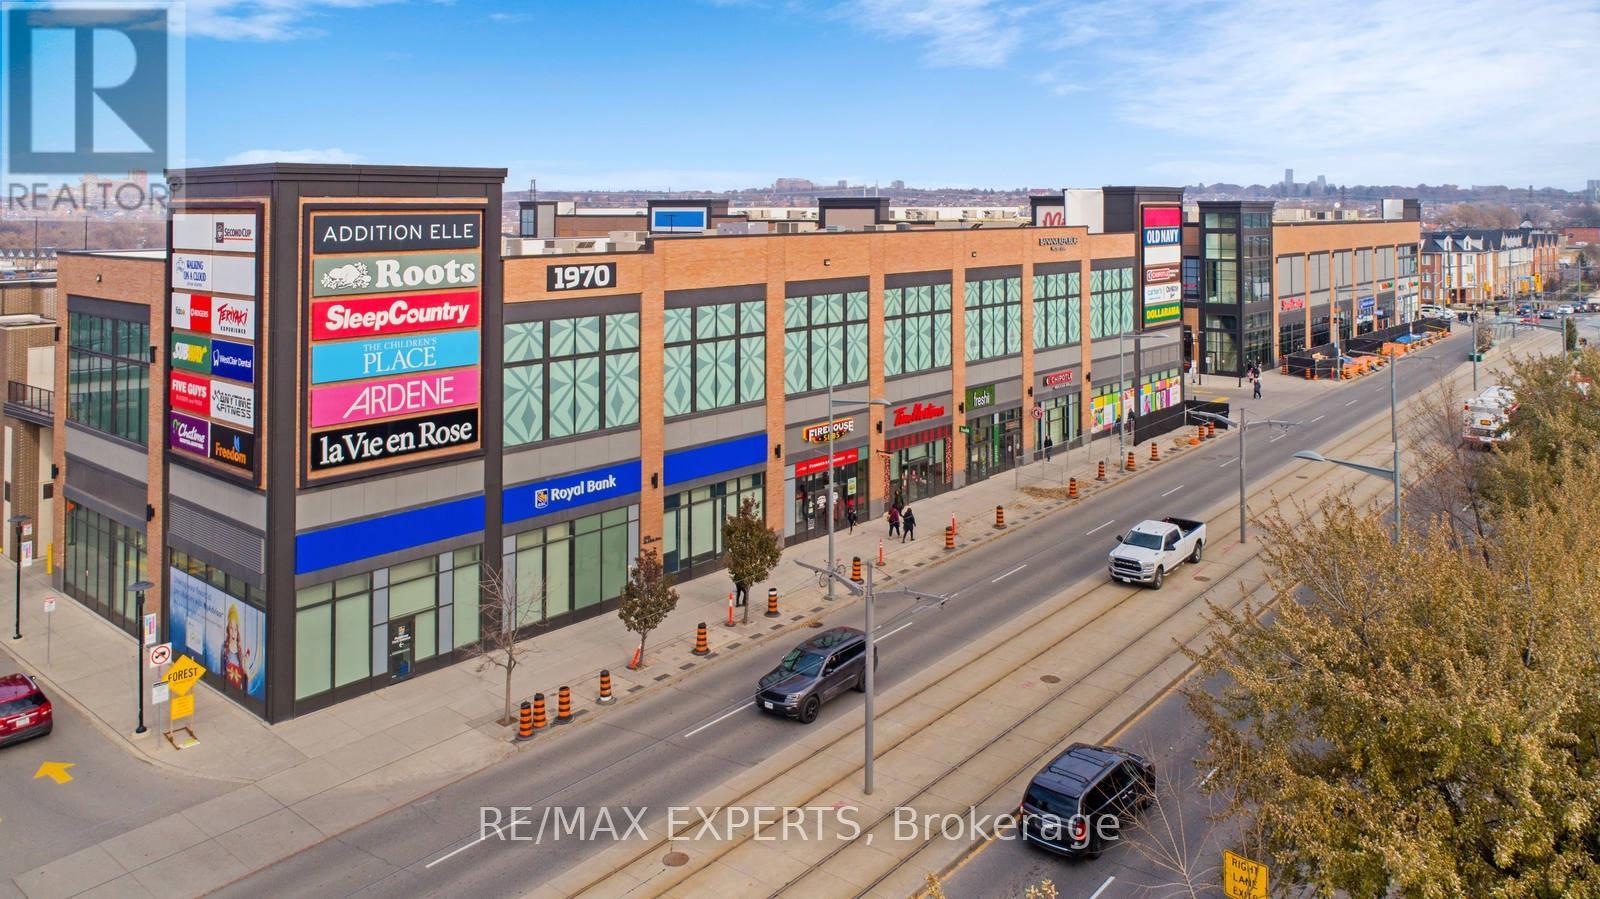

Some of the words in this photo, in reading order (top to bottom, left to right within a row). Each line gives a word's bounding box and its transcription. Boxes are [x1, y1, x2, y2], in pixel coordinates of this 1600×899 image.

[323, 223, 422, 242] ADDITION
[430, 223, 474, 240] ELLE
[1147, 229, 1161, 244] OLD
[1161, 228, 1179, 243] NAVY
[375, 258, 476, 289] Roots
[553, 264, 610, 290] 1970
[325, 300, 471, 331] SleepCountry
[1146, 305, 1180, 320] DOLLARAMA
[220, 326, 246, 335] EXPERIENCE
[173, 342, 207, 364] SUBWAY
[363, 343, 382, 353] THE
[384, 336, 437, 351] CHILDREN'S
[238, 358, 251, 368] Dental
[363, 346, 437, 375] PLACE
[172, 379, 187, 393] FIVE
[187, 383, 207, 398] GUYS
[342, 376, 455, 419] ARDENE
[220, 391, 252, 410] ANYTIME
[220, 403, 252, 419] FITNESS
[178, 423, 206, 443] Chatime
[386, 433, 415, 453] en
[418, 421, 473, 448] Rose
[215, 442, 247, 465] Freedom
[551, 480, 584, 507] Royal
[587, 474, 617, 495] Bank
[167, 667, 198, 683] FOREST
